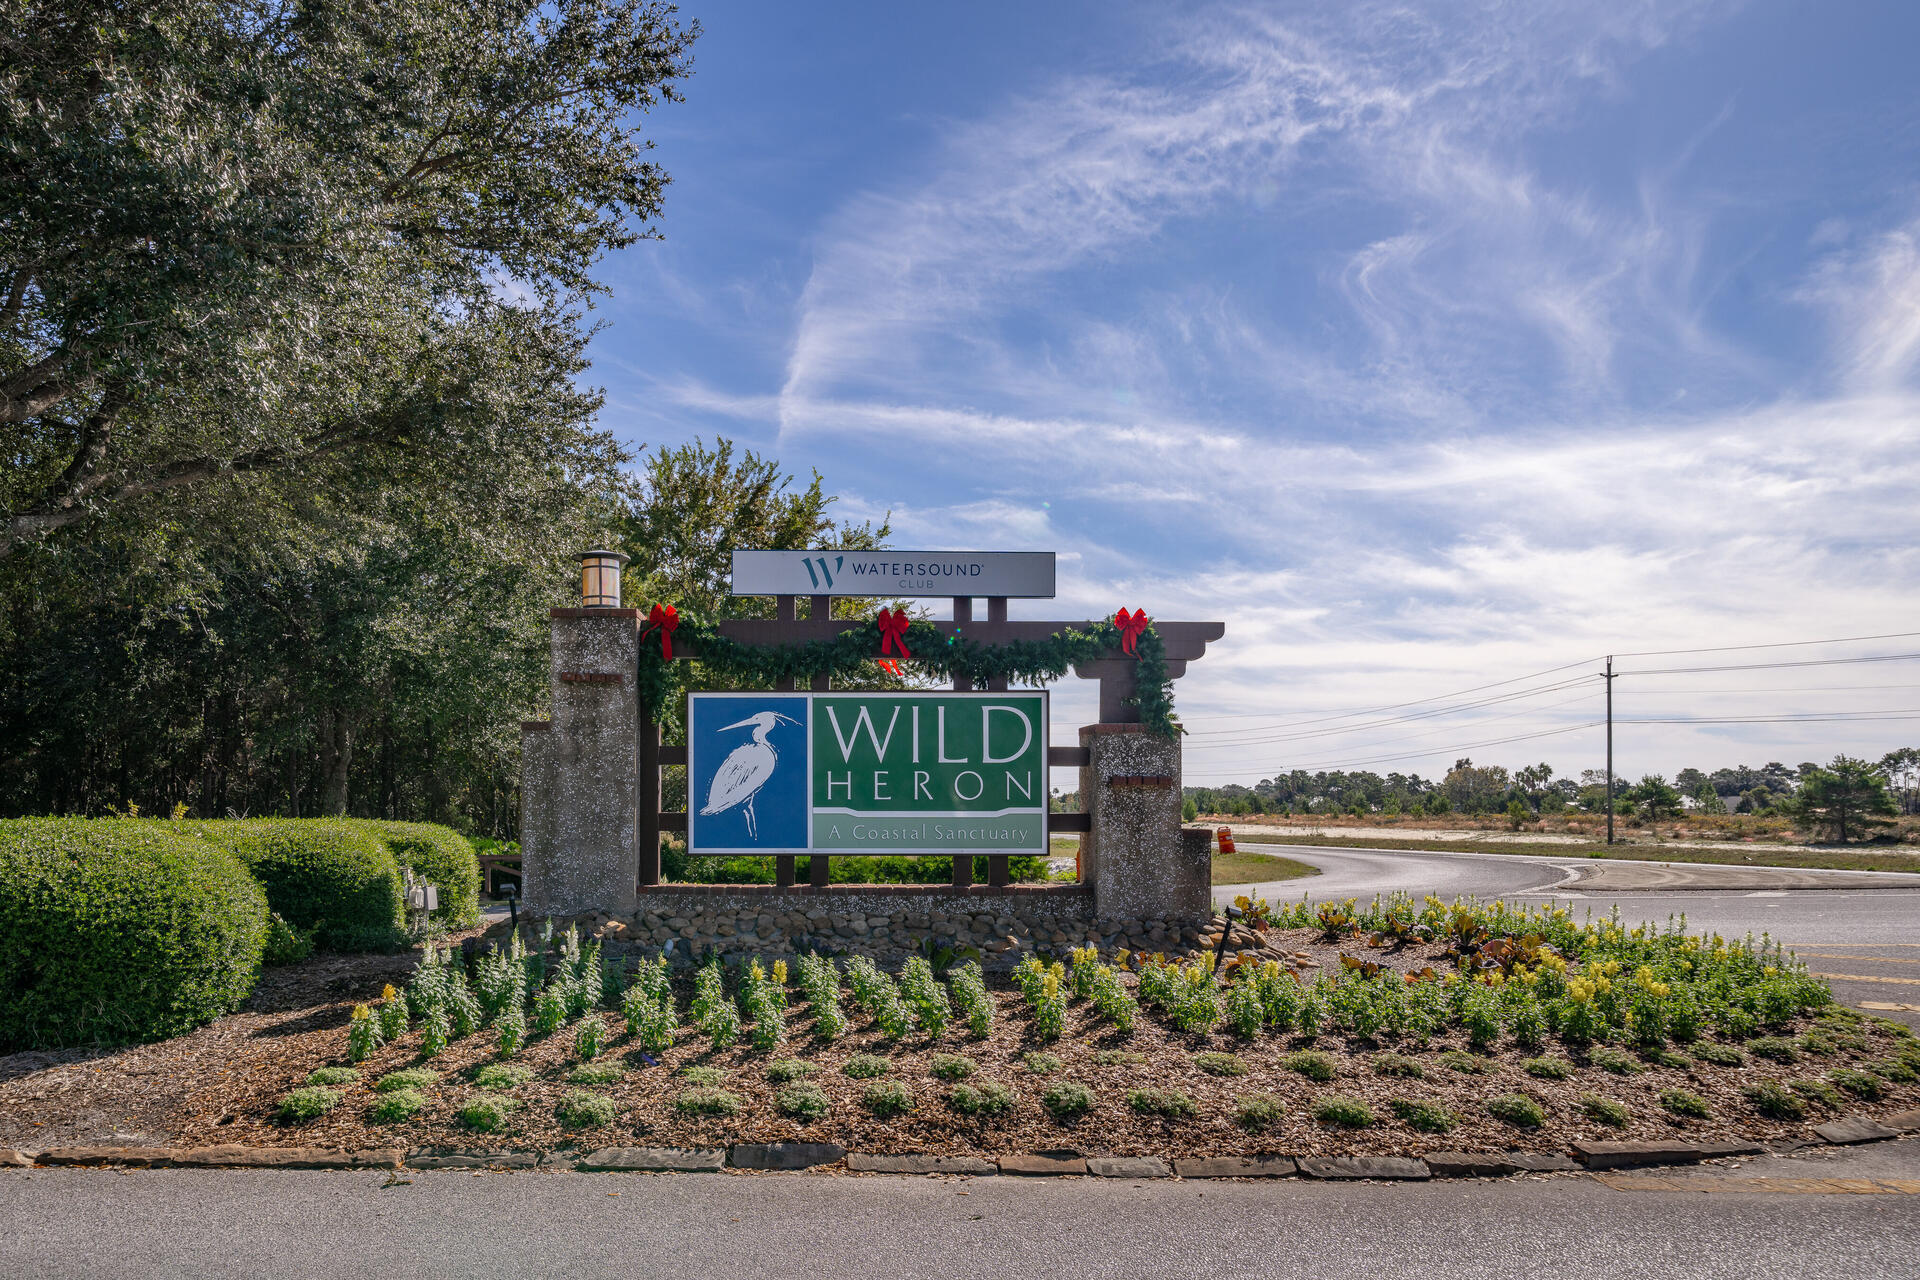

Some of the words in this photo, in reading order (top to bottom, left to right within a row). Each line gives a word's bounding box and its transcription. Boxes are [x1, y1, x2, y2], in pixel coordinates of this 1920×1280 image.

[852, 562, 982, 577] WATERSOUND
[898, 579, 934, 589] CLUB
[825, 705, 1033, 764] WILD
[826, 770, 1032, 801] HERON
[828, 824, 841, 840] A
[852, 823, 927, 840] Coastal
[934, 823, 1029, 844] Sanctuary
